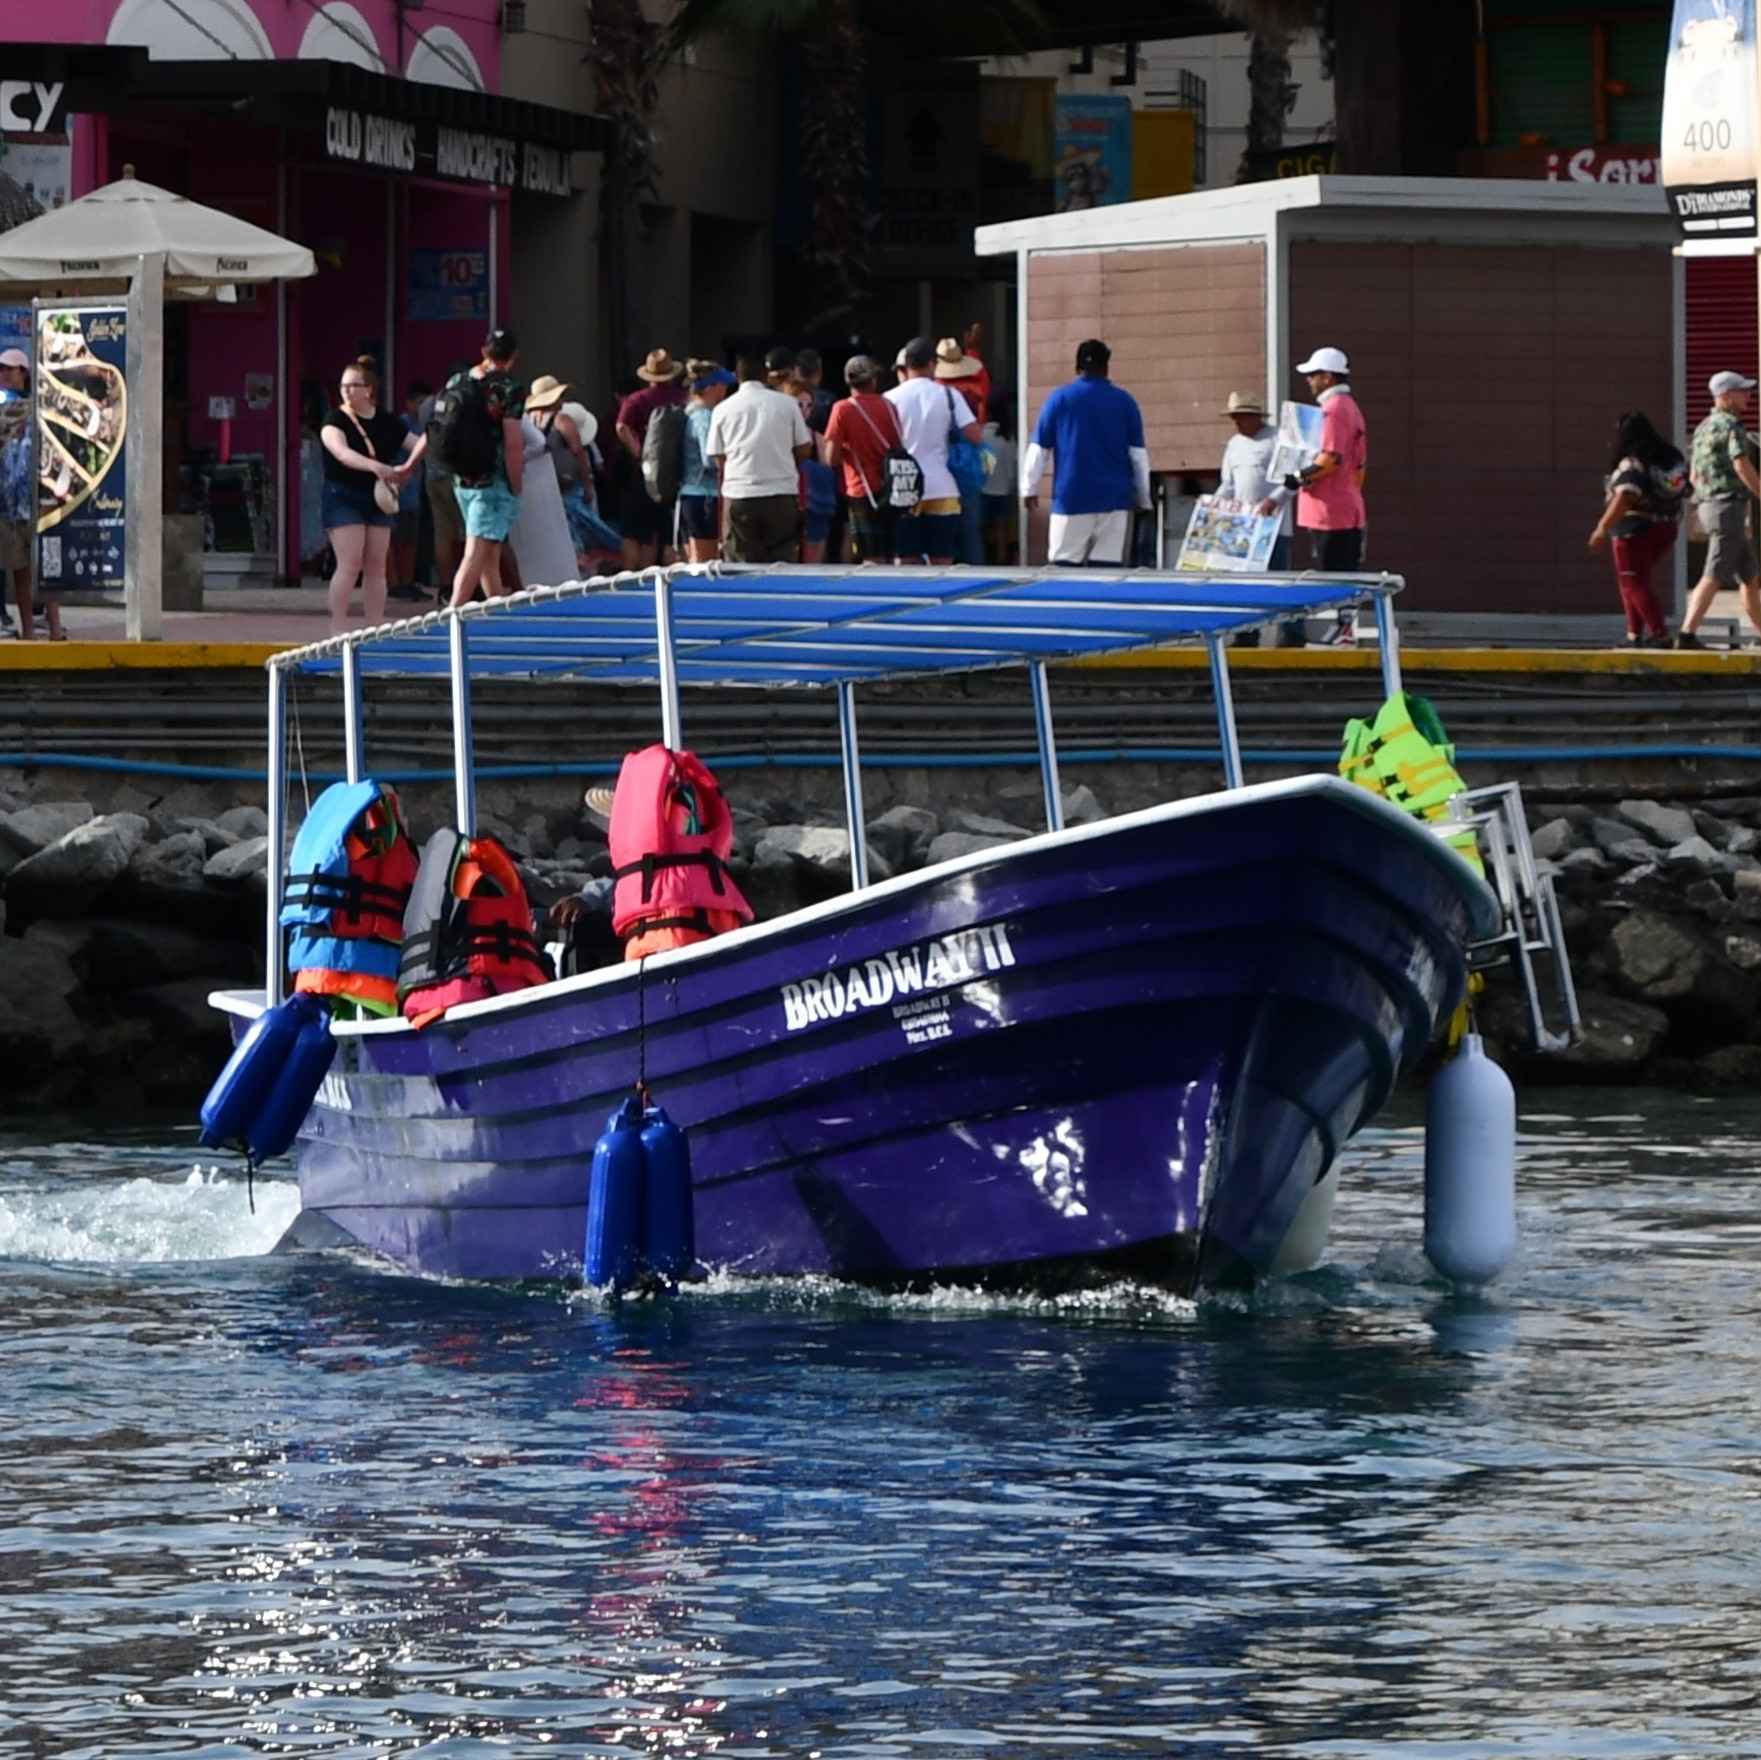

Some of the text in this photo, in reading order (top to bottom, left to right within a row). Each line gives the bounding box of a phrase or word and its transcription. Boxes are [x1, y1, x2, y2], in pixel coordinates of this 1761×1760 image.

[325, 105, 417, 172] COLD DRINKS
[436, 127, 517, 186] HANDCRAFTS
[1683, 118, 1733, 152] 400
[780, 923, 1017, 1032] BROADWAY II
